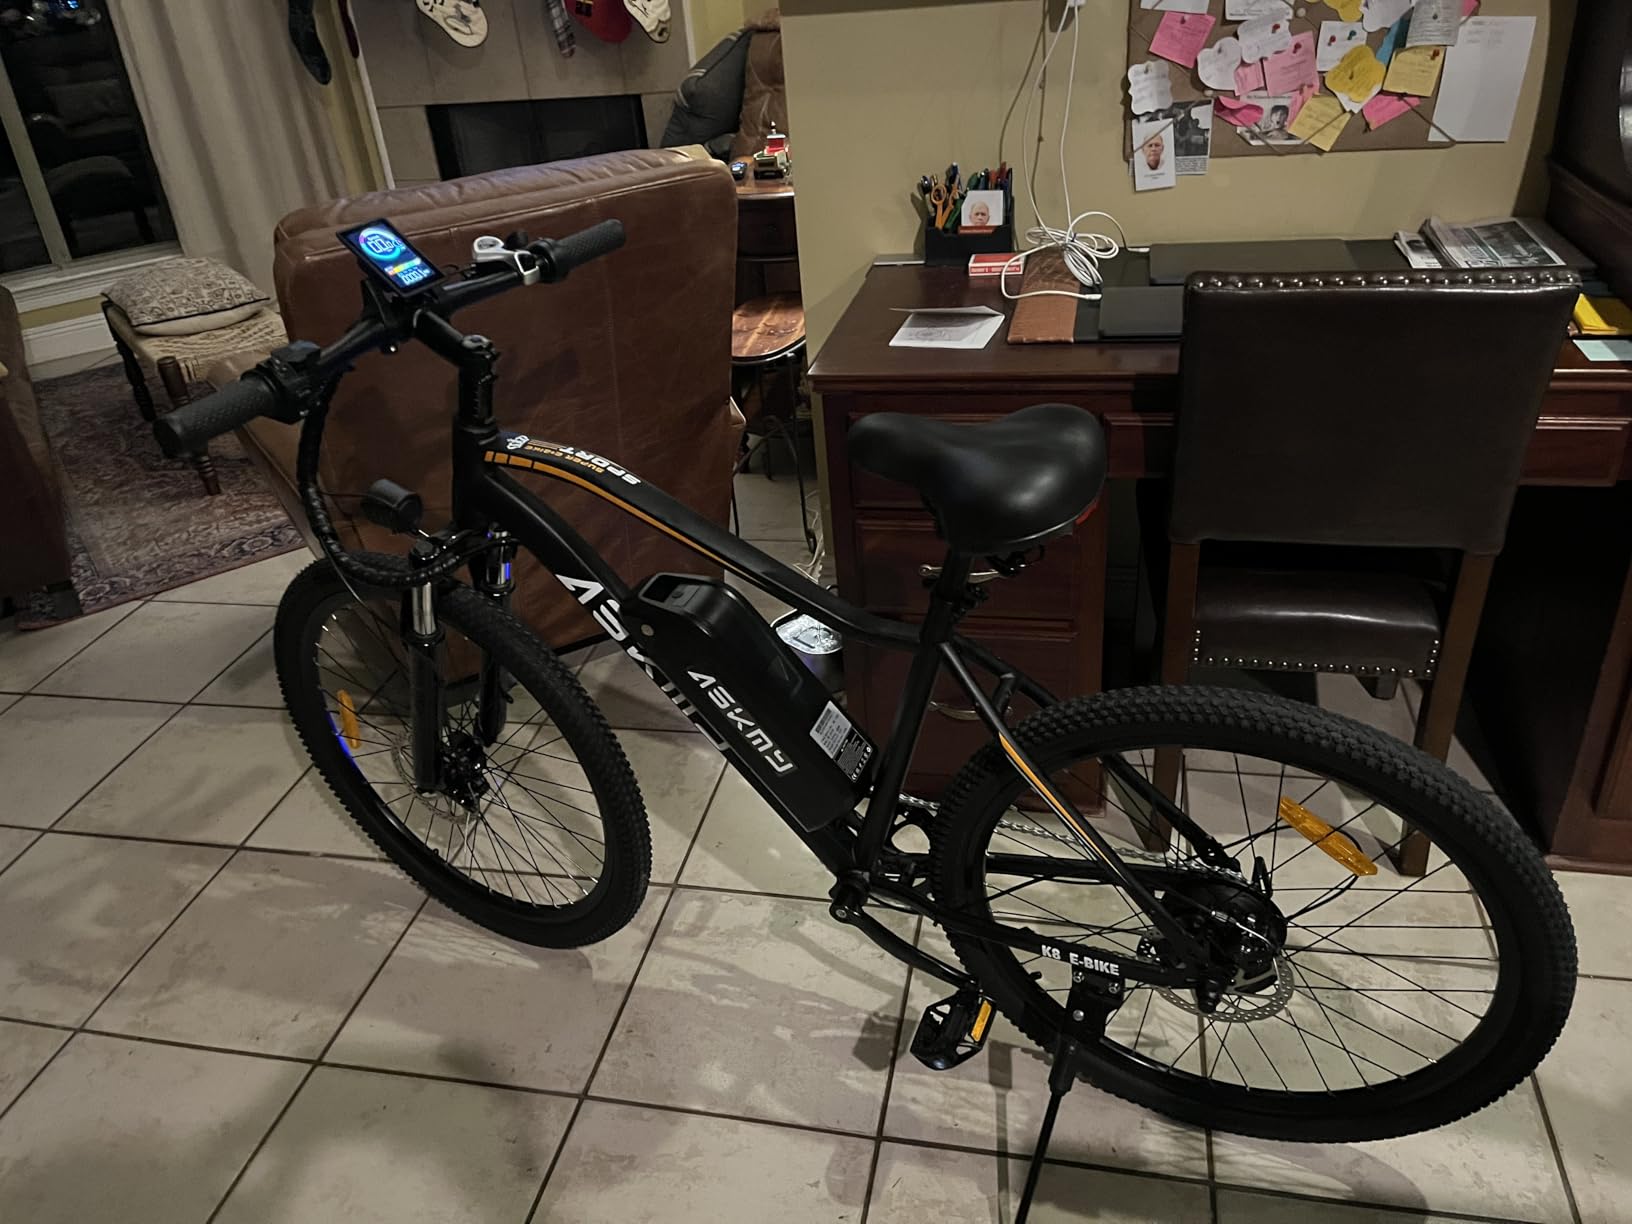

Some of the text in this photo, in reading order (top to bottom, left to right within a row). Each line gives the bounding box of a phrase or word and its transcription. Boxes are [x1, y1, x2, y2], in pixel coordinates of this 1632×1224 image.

[558, 446, 642, 485] SPORT
[565, 454, 604, 473] SUPER
[1041, 944, 1120, 976] K8 E-BIKE
